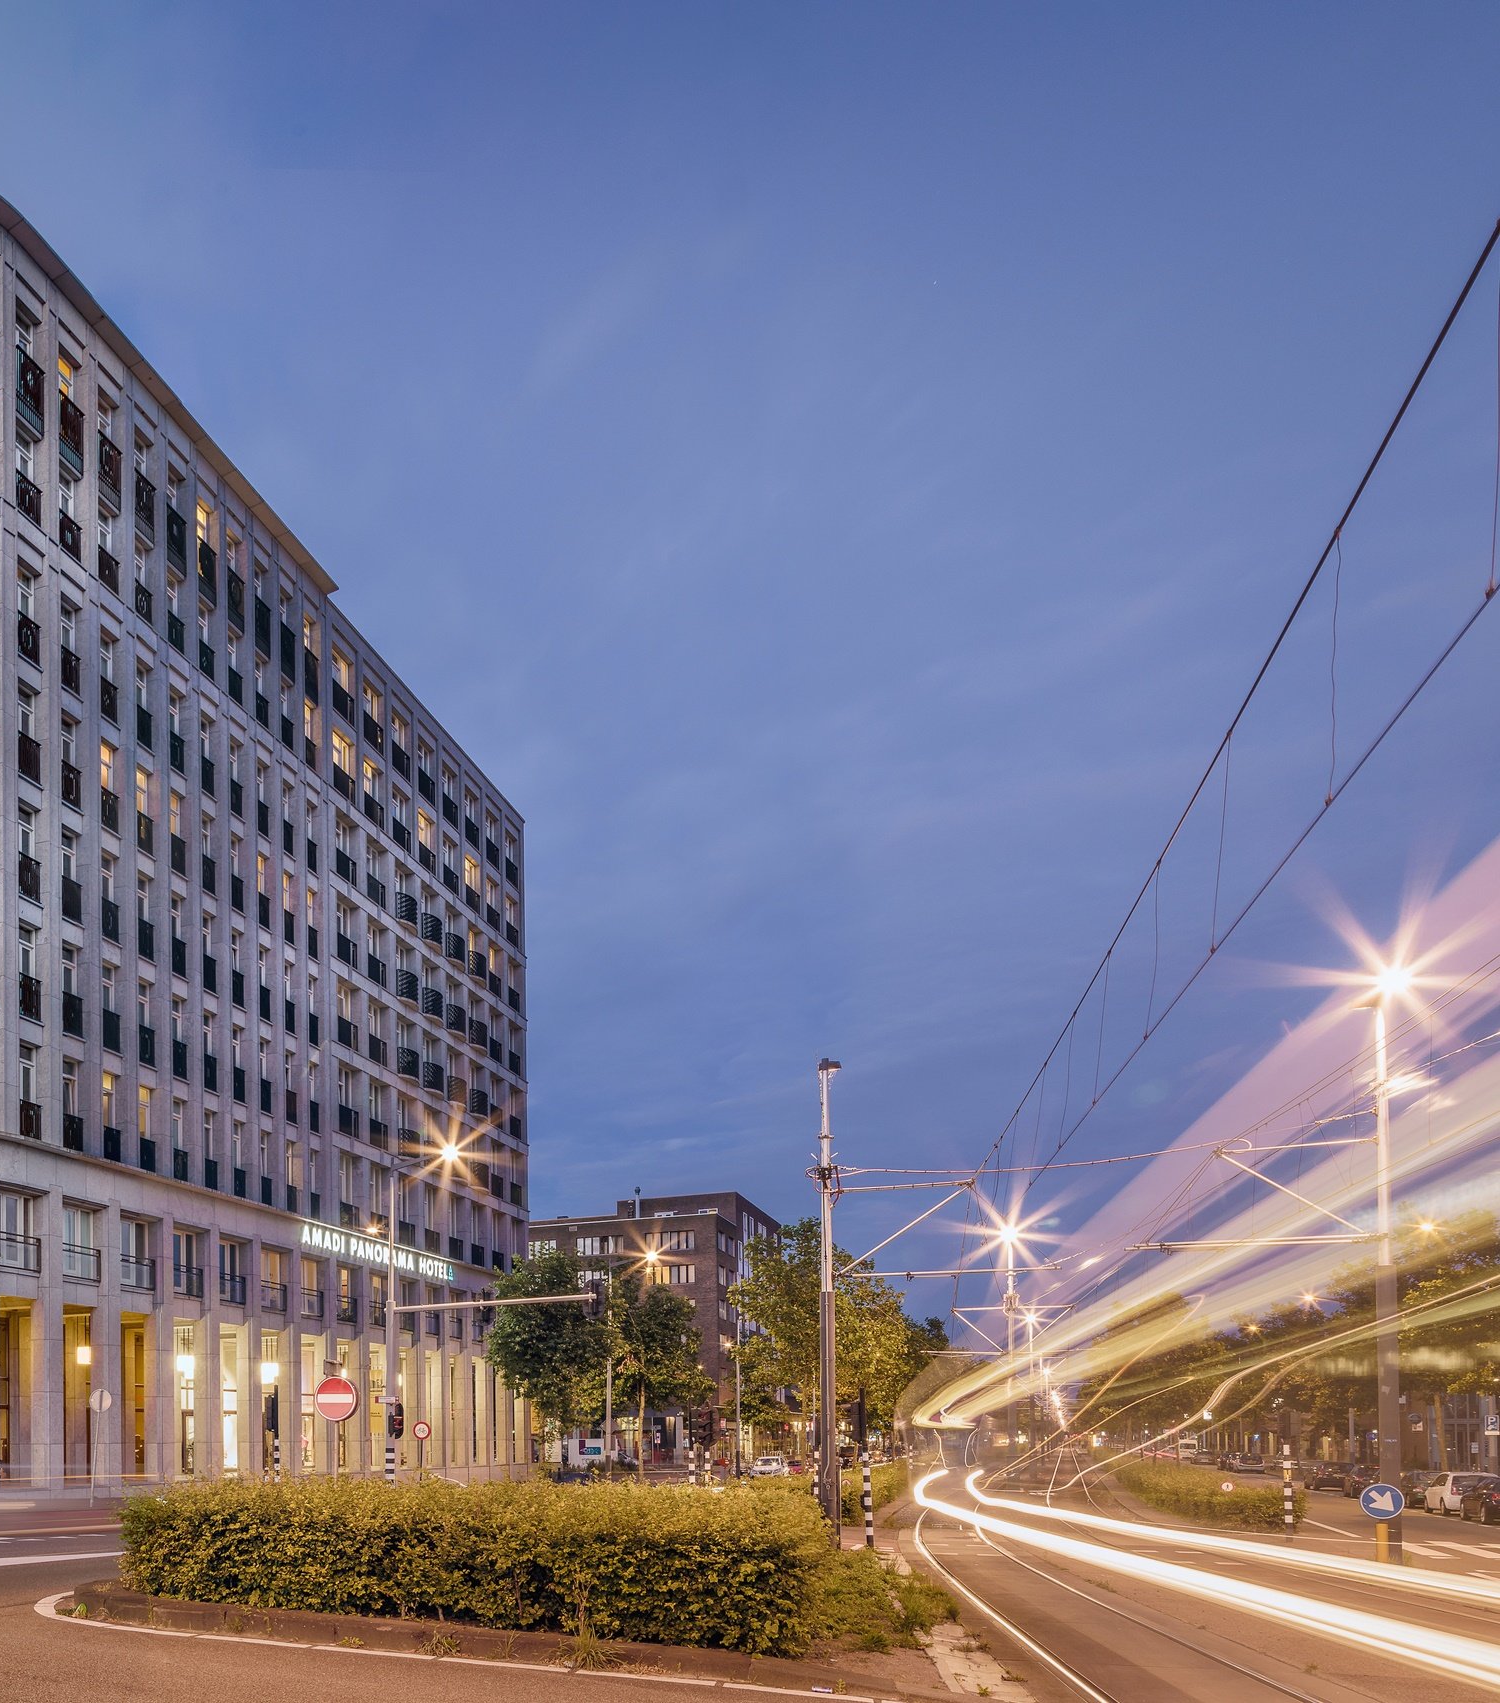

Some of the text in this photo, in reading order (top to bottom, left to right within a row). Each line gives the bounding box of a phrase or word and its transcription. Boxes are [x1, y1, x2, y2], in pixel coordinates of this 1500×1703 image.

[302, 1225, 345, 1254] AMADI
[419, 1256, 448, 1280] HOTEL
[1488, 1416, 1496, 1425] P
